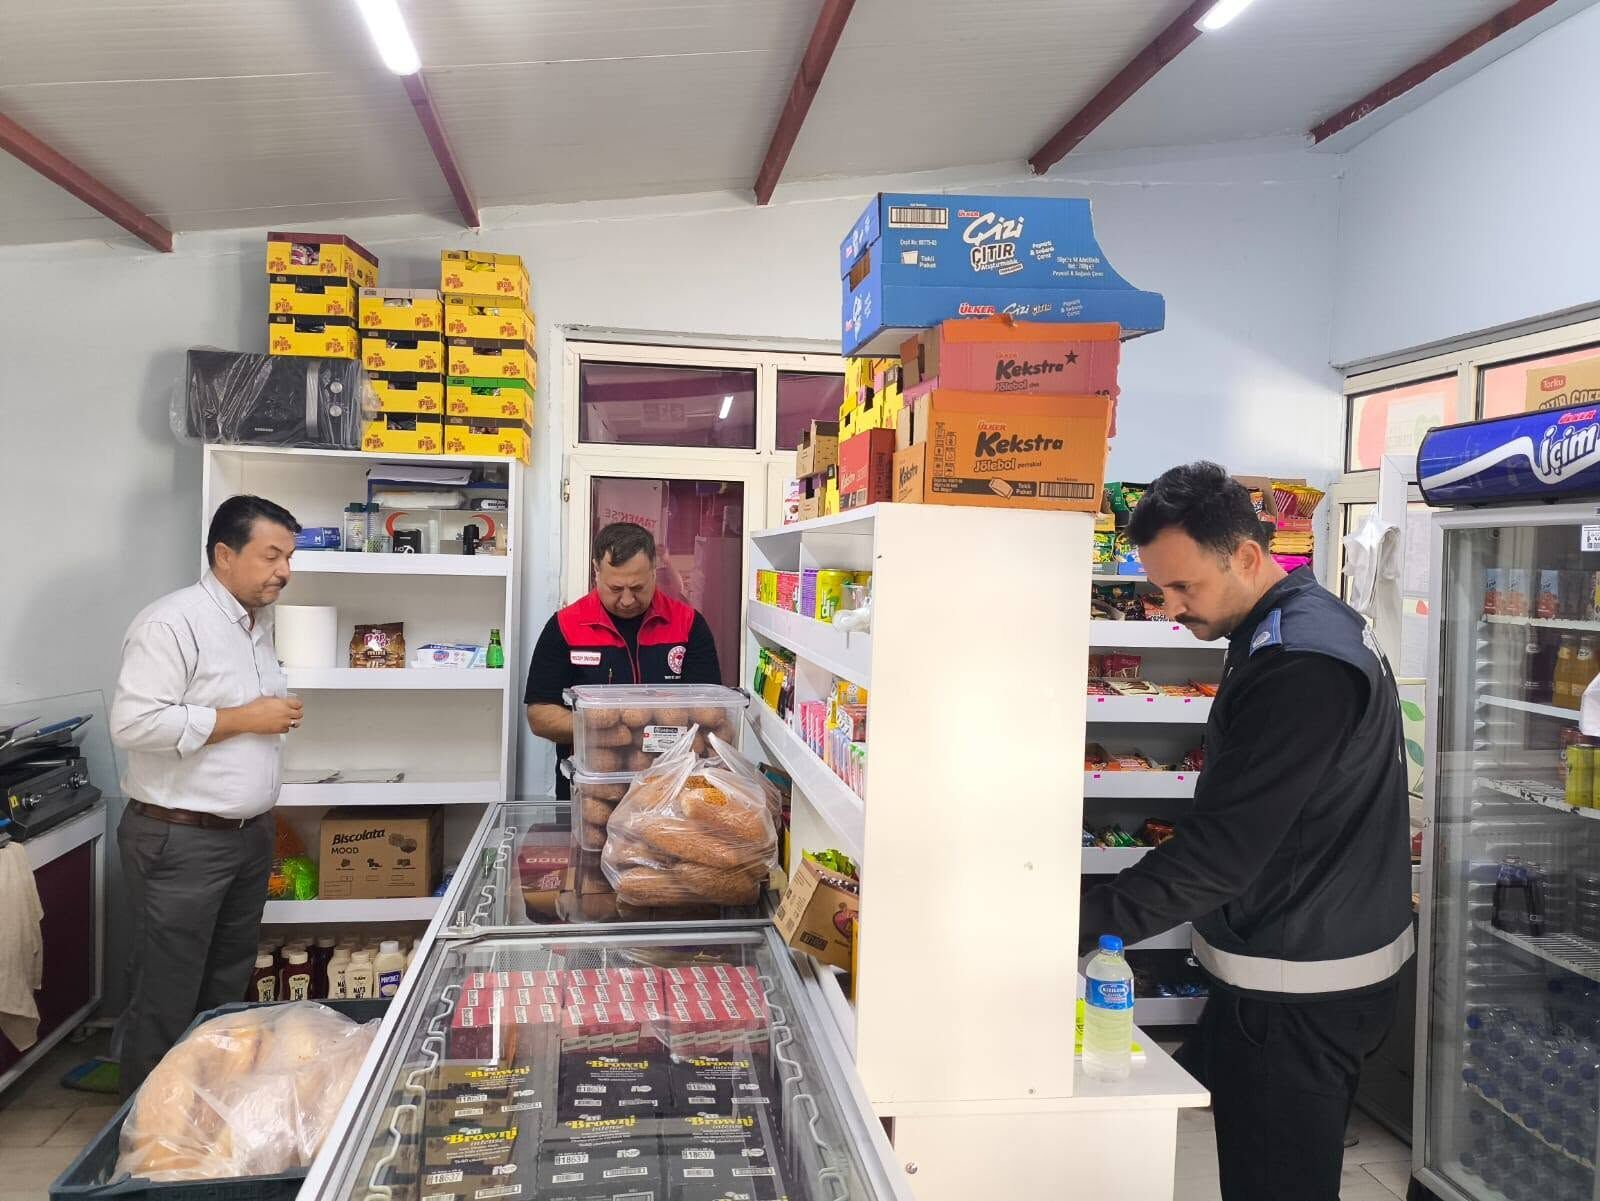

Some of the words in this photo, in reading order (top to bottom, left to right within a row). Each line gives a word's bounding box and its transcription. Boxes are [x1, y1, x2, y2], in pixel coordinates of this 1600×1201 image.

[963, 212, 1025, 247] Çizi
[971, 243, 1015, 272] ÇITIR
[959, 302, 997, 315] ÜLKER
[996, 360, 1064, 381] Kekstra
[1542, 377, 1565, 389] Torku
[977, 421, 1007, 431] ÜLKER
[975, 432, 1064, 458] Kekstra
[974, 458, 1016, 472] Jölebol
[331, 828, 386, 846] Biscolata
[331, 847, 360, 855] MOOD
[586, 1060, 649, 1069] Browni
[689, 1059, 750, 1068] Browni
[564, 1115, 637, 1129] Browni
[685, 1116, 754, 1127] Browni
[443, 1127, 518, 1144] Browni
